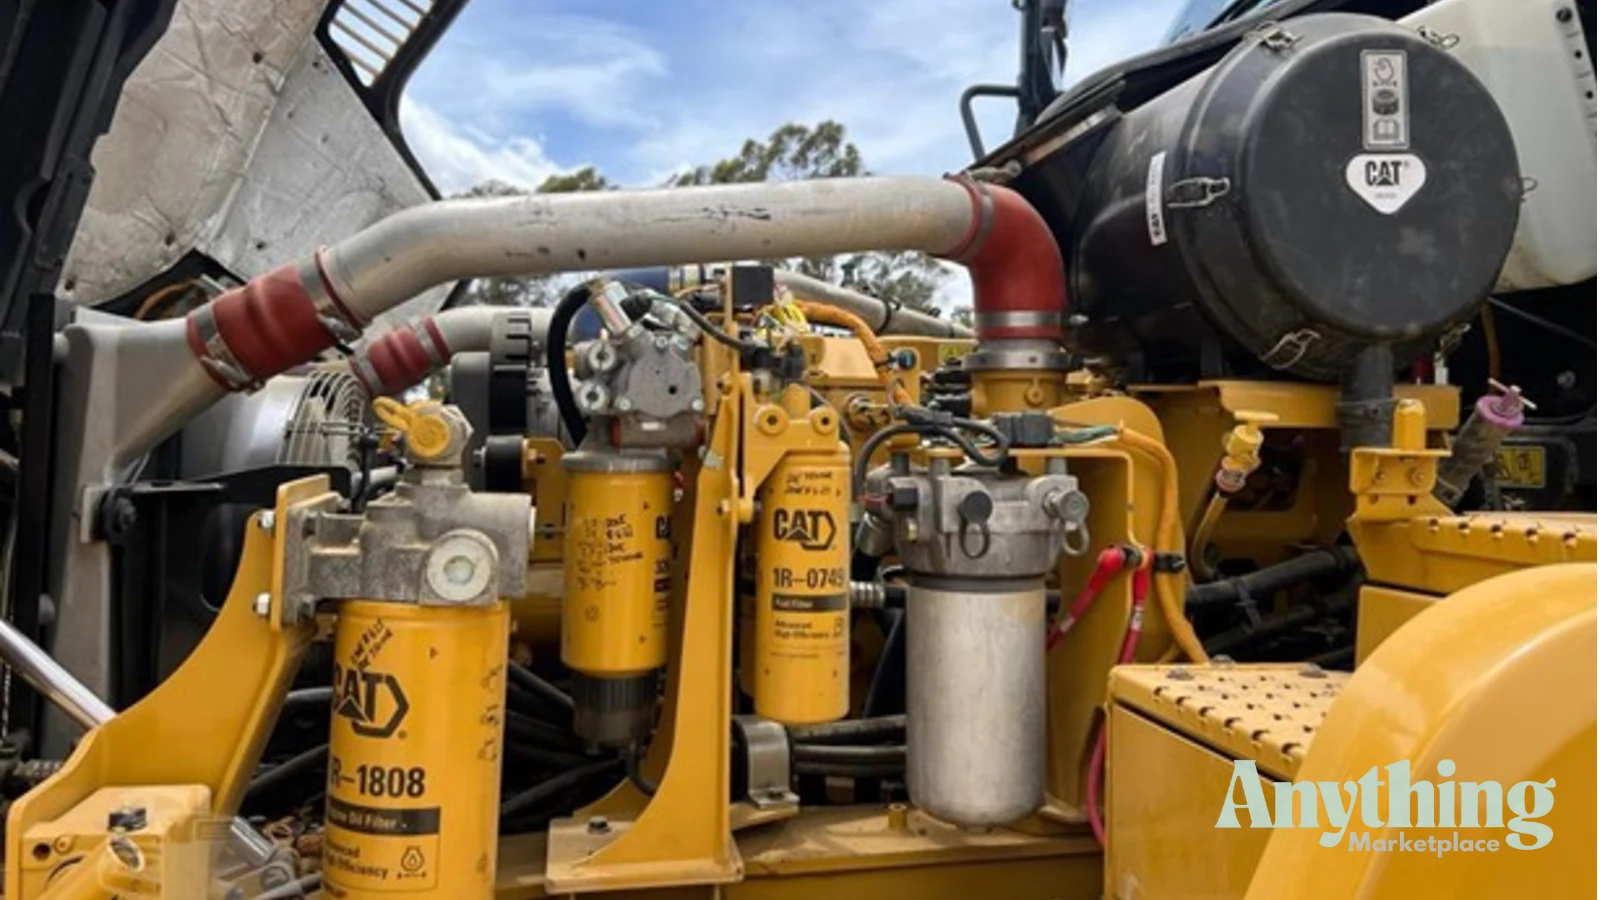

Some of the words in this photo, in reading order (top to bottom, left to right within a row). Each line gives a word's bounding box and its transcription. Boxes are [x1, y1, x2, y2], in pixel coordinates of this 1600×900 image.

[1365, 160, 1403, 187] CAT
[773, 508, 821, 542] CAT
[330, 756, 426, 799] R-1808
[364, 813, 397, 831] Filter
